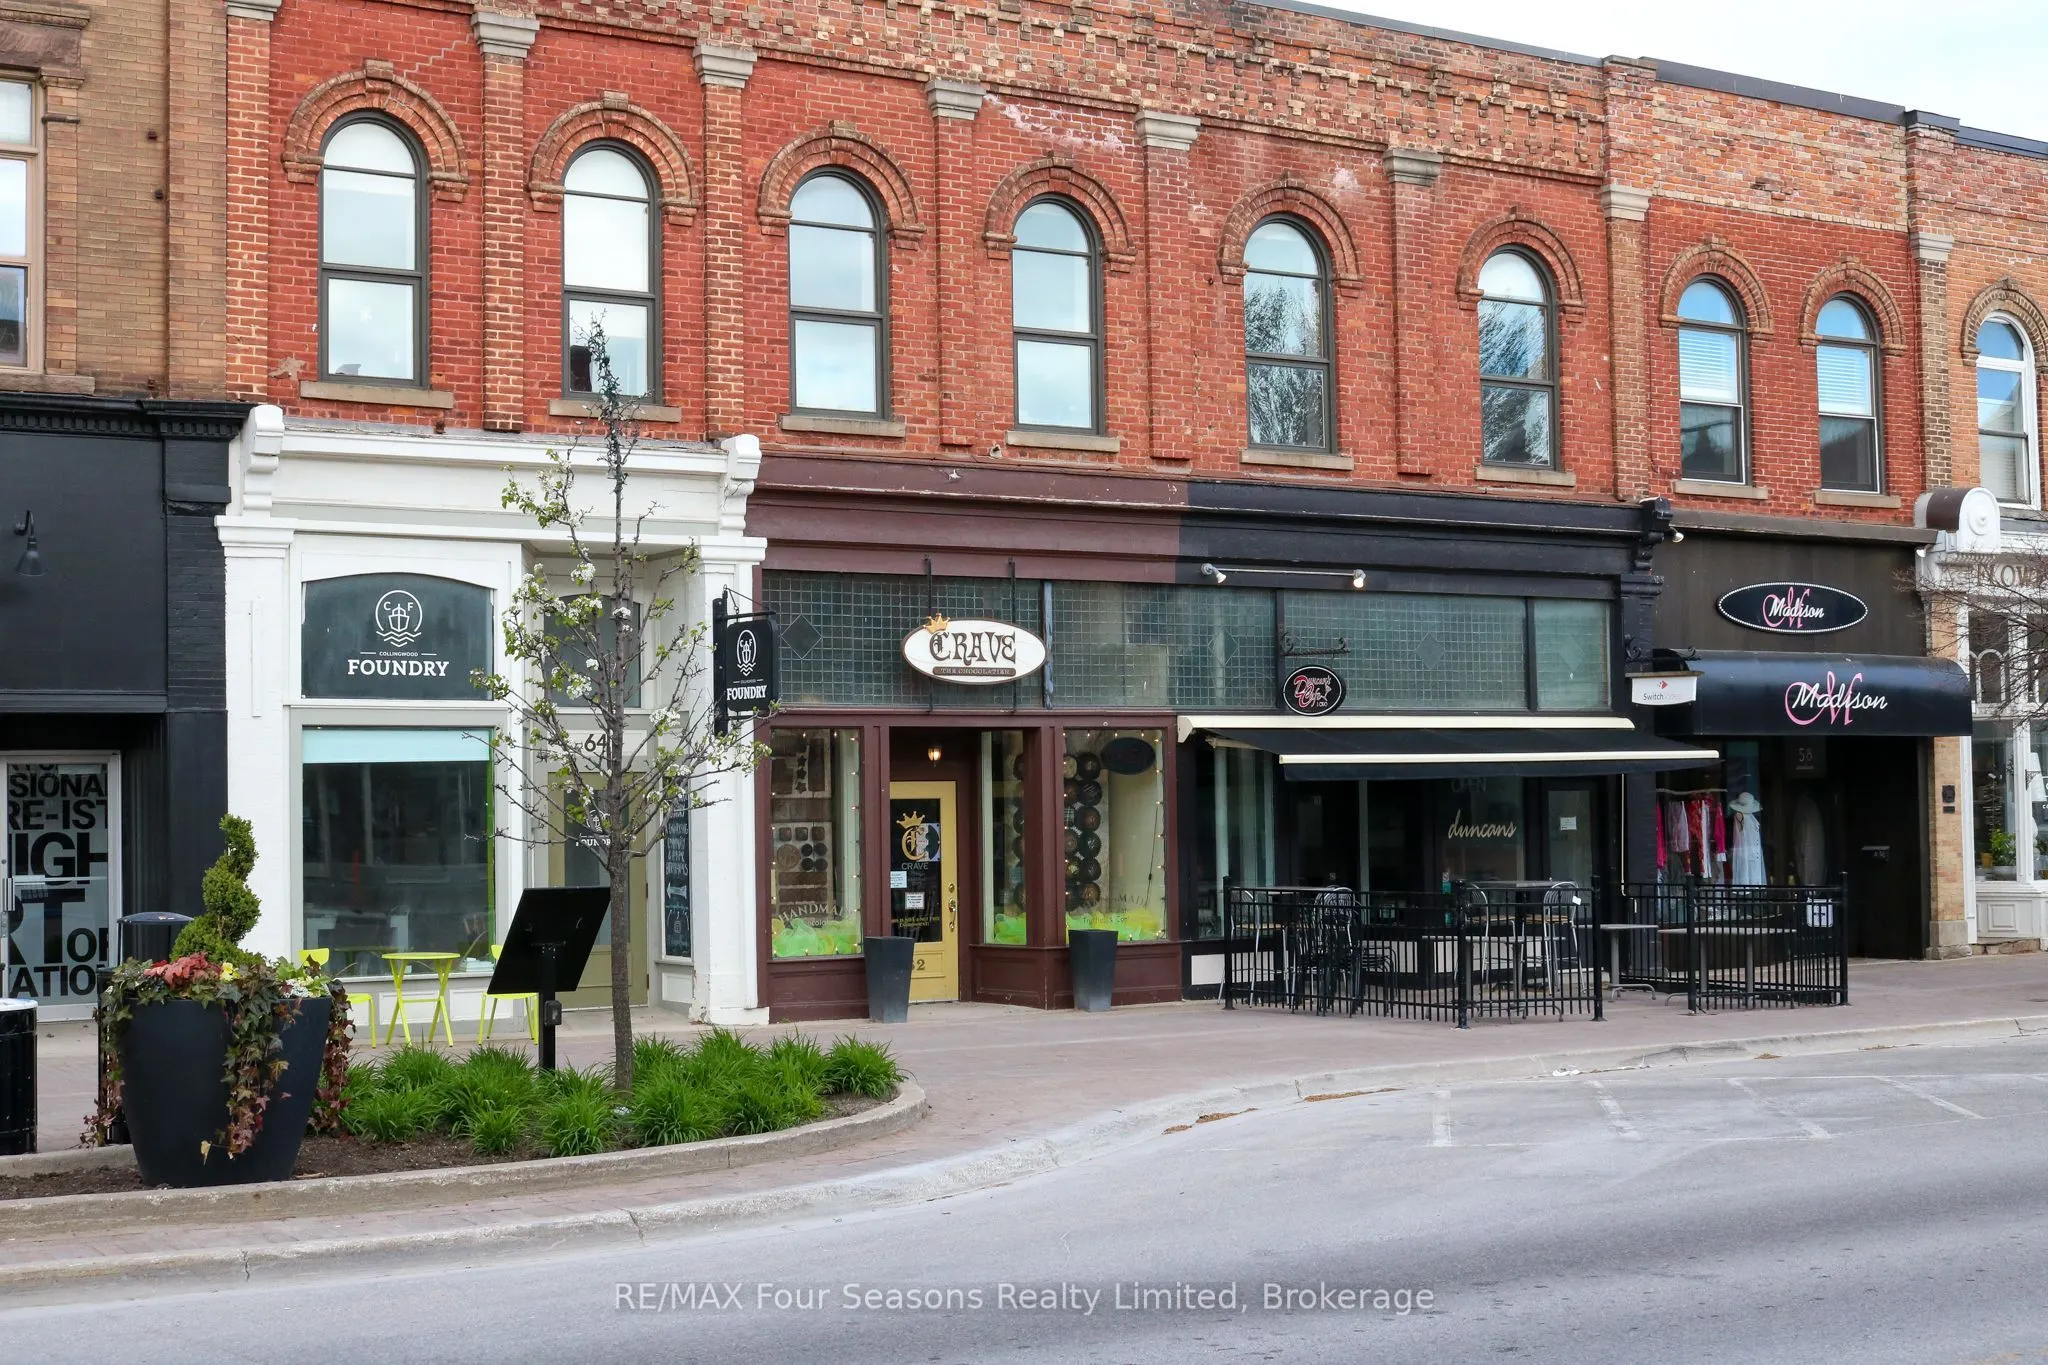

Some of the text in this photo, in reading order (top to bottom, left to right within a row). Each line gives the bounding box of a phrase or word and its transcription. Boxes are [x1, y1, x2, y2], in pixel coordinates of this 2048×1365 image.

[1769, 597, 1825, 618] Madison
[929, 631, 1016, 666] CRAVE
[347, 659, 449, 677] FOUNDRY
[726, 685, 767, 700] FOUNDRY
[1792, 683, 1888, 709] Madison
[9, 773, 108, 798] SIONA
[1448, 808, 1517, 839] duncans
[901, 862, 929, 871] CRAVE
